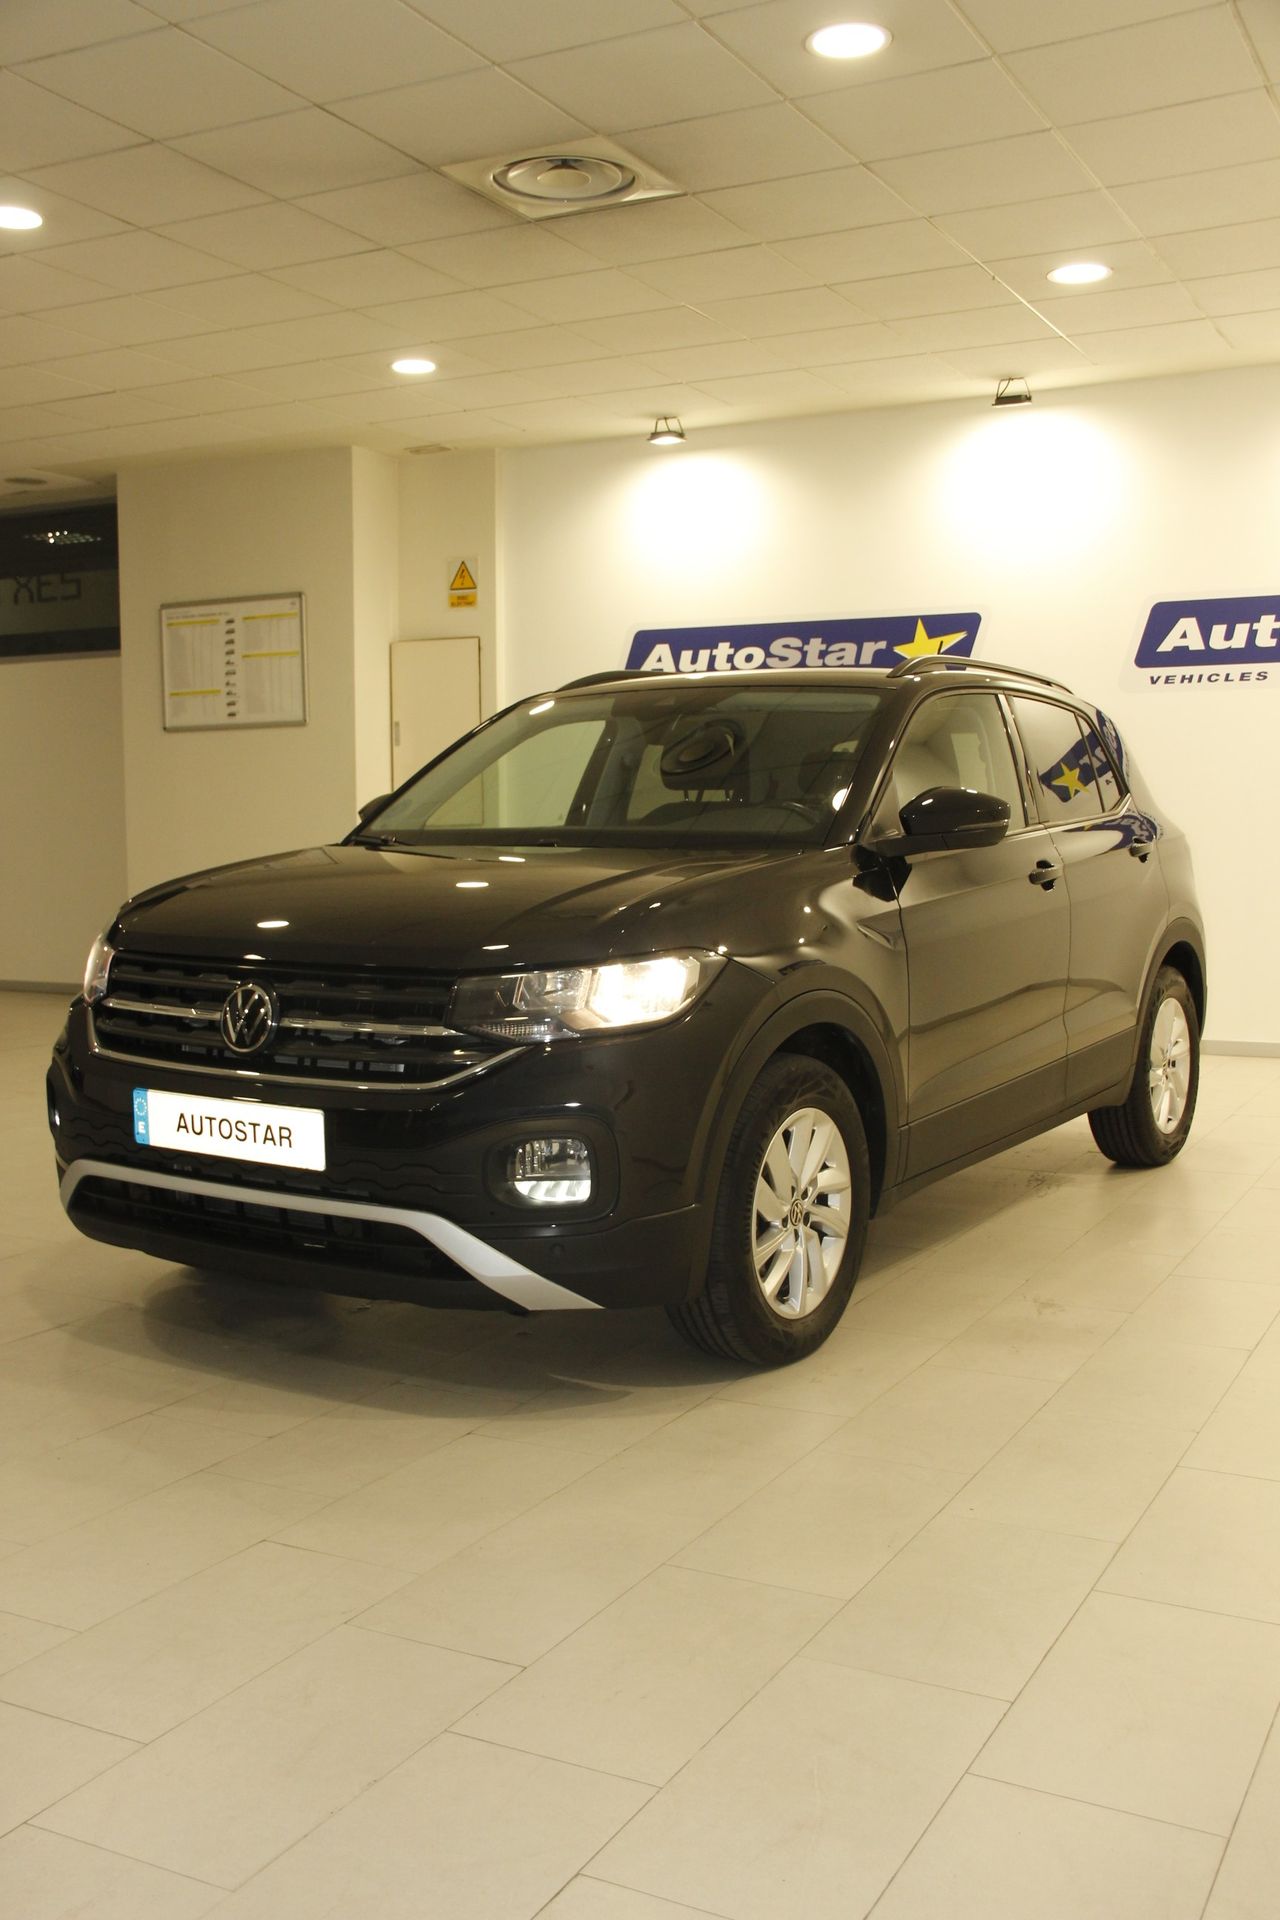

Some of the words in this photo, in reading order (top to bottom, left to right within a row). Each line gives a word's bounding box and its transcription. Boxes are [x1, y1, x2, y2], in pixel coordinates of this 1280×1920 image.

[641, 637, 887, 672] AutoStar
[1150, 671, 1268, 685] VEHICLES
[138, 1121, 146, 1134] E
[176, 1112, 293, 1148] AUTOSTAR
